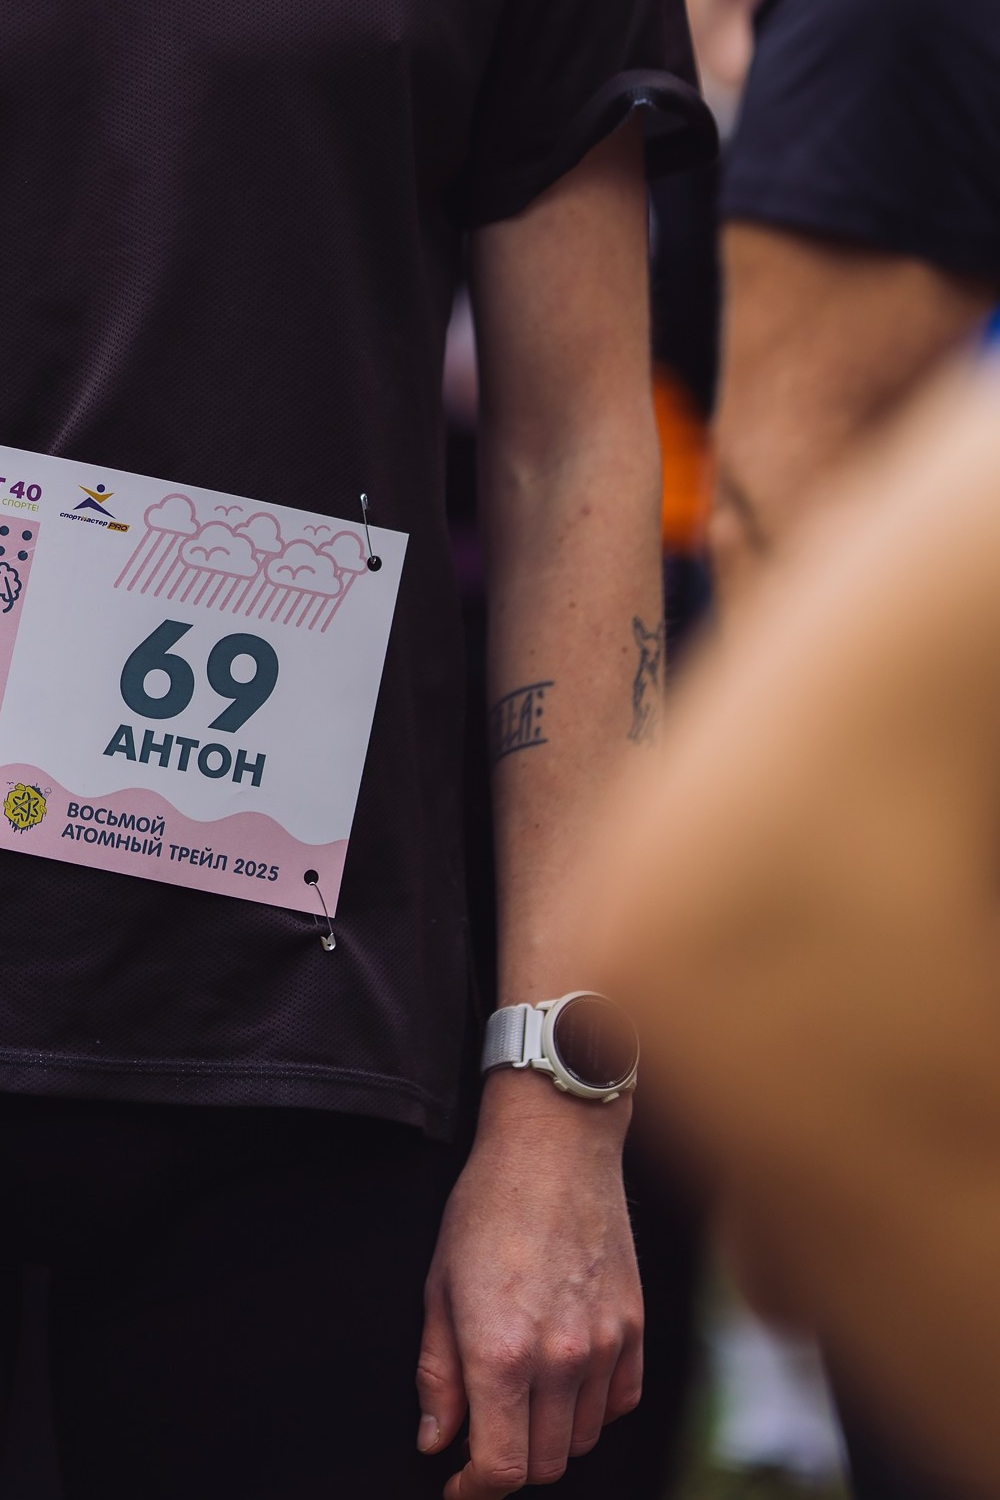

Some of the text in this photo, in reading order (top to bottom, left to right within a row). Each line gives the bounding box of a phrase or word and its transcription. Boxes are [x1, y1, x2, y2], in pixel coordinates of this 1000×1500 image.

[2, 498, 40, 512] СПОРТЕ!
[9, 481, 42, 501] 40
[108, 522, 129, 532] PRO
[119, 619, 279, 733] 69
[103, 724, 266, 787] АНТОН
[67, 801, 165, 836] ВОСЬМОЙ
[62, 823, 280, 882] АТОМНЫЙ ТРЕЙЛ 2025
